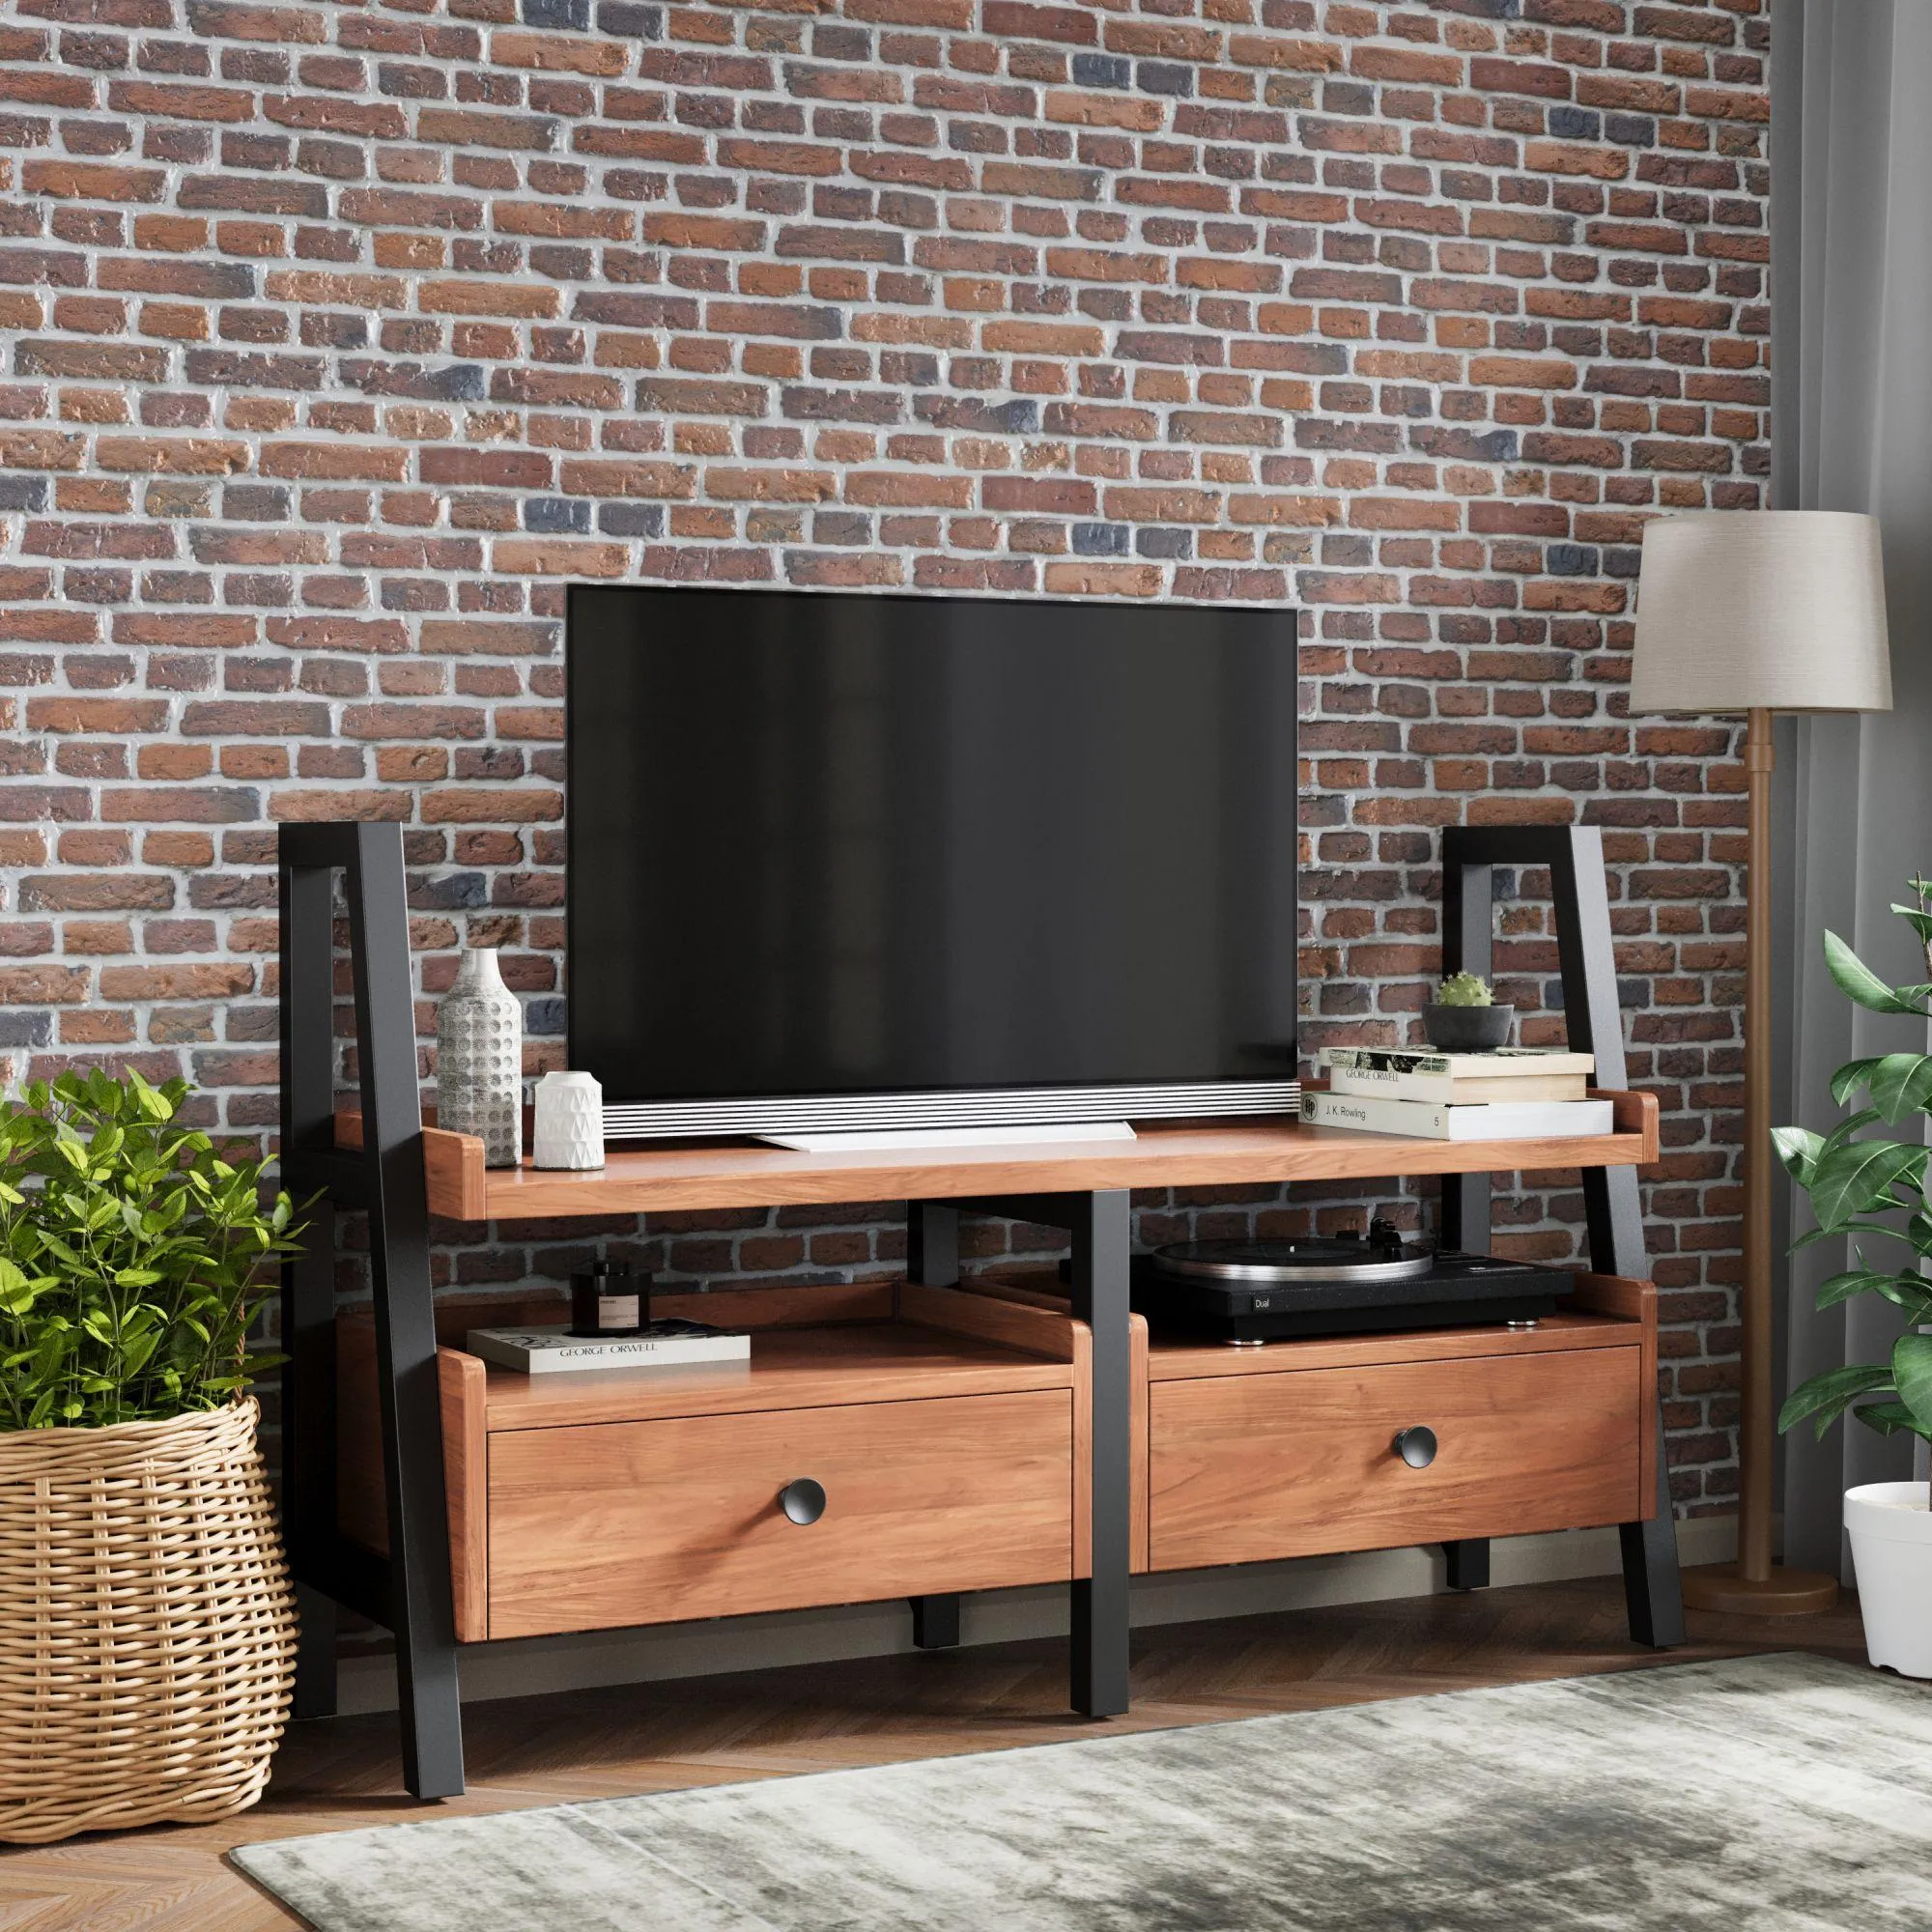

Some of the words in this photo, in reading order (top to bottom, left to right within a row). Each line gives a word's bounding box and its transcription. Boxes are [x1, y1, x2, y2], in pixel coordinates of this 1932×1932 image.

[1346, 1069, 1372, 1081] GEORGE
[1373, 1071, 1399, 1083] ORWELL
[1341, 1107, 1366, 1121] Rowling
[1434, 1117, 1439, 1126] 5
[1255, 1298, 1268, 1308] Dual
[559, 1347, 606, 1357] GEORGE
[610, 1343, 657, 1353] ORWELL
